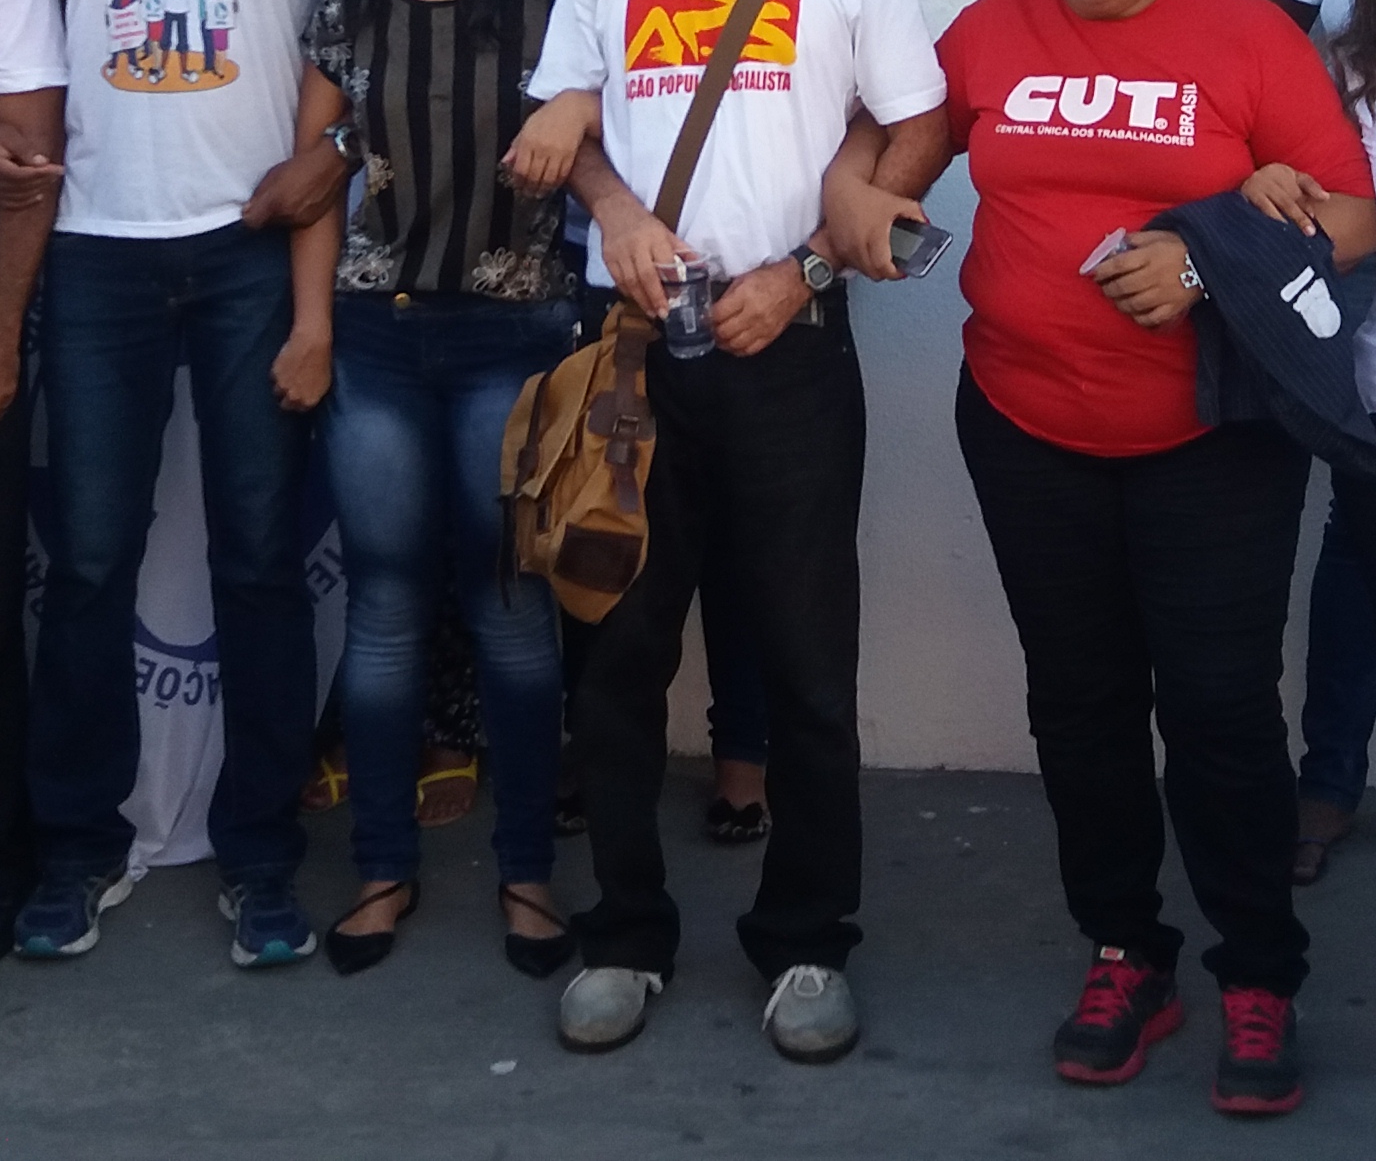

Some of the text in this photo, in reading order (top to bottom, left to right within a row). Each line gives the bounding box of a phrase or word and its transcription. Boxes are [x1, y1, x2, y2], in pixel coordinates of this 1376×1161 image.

[659, 72, 699, 96] POPU
[726, 70, 791, 92] OCIALISTA
[1178, 82, 1198, 137] BRASIL
[995, 123, 1195, 147] CENTRAL ÚNICA DOS TRABALHADORES
